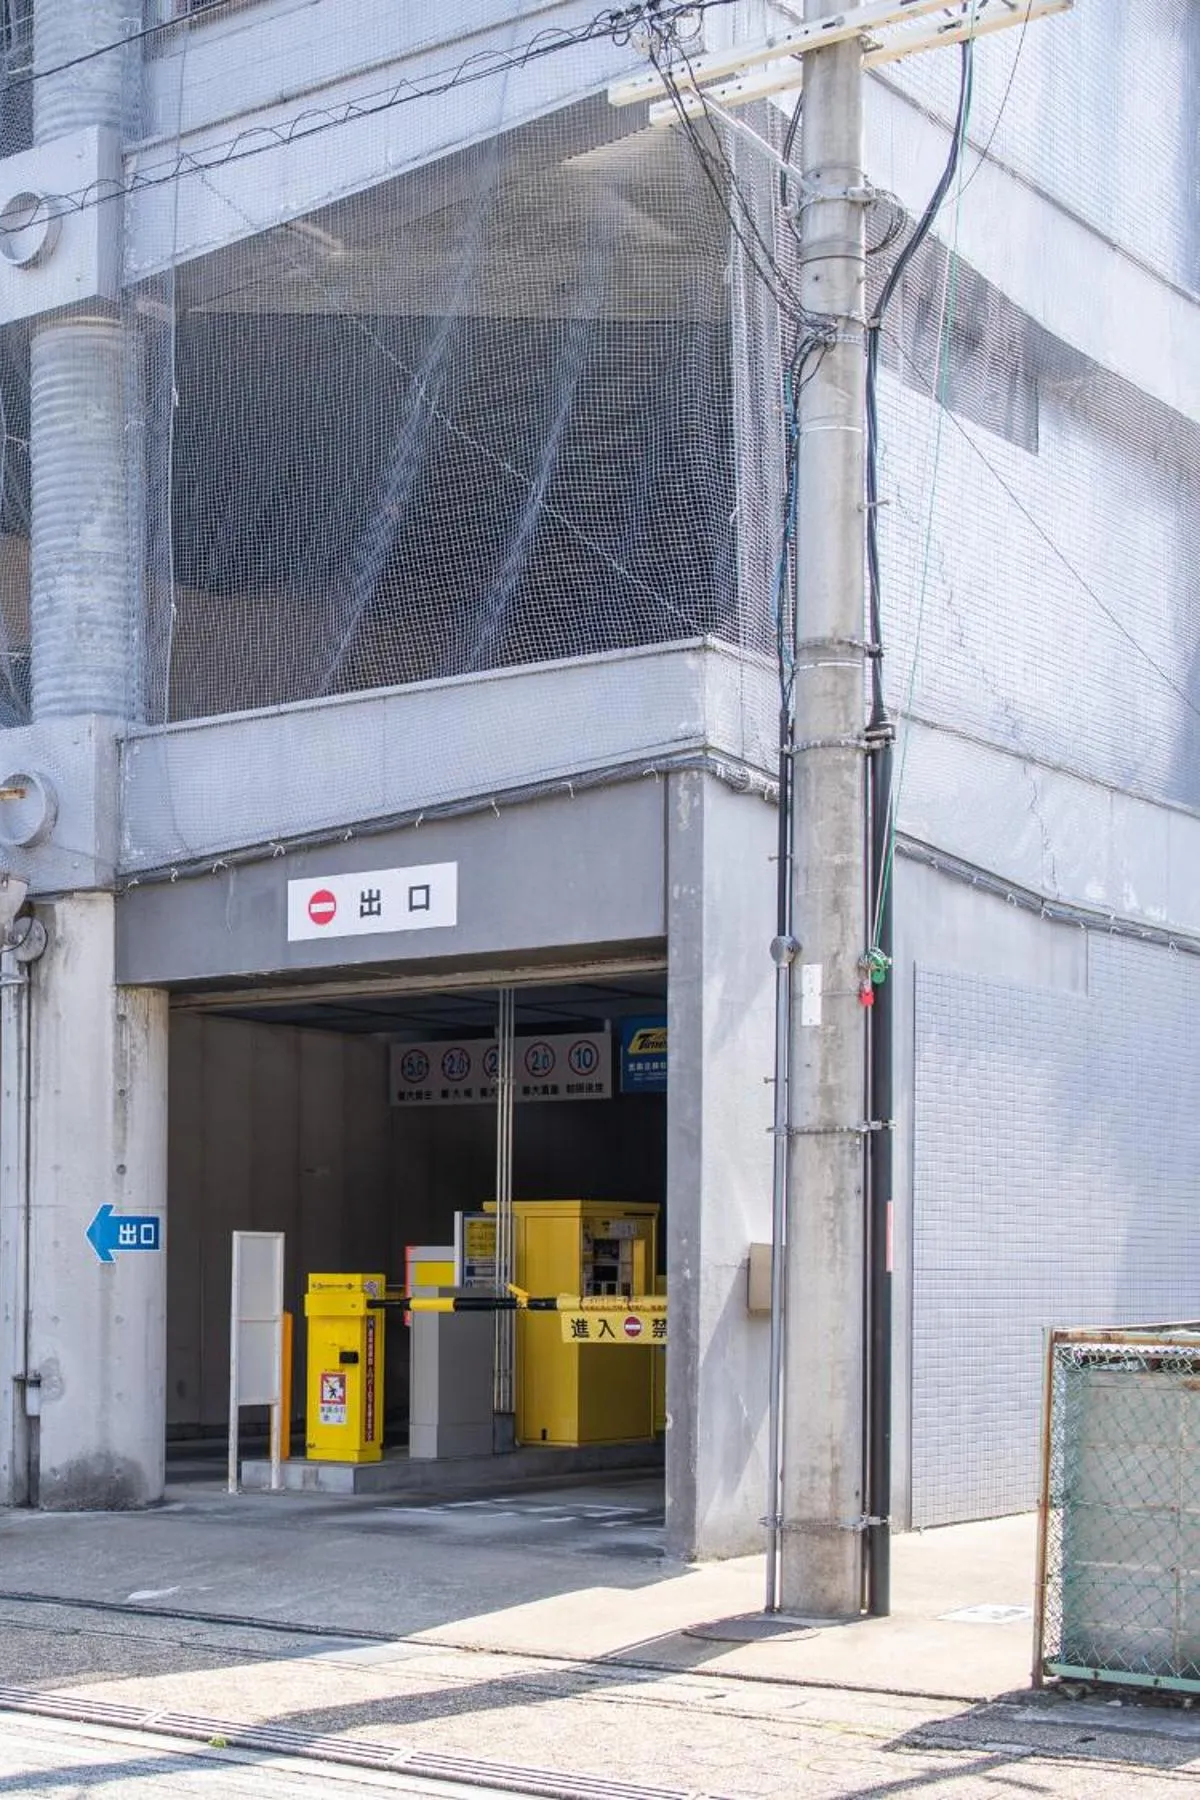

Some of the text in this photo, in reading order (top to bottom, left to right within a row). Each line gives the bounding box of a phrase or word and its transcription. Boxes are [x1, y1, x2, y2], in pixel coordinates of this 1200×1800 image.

[359, 884, 430, 918] 出口
[575, 1047, 593, 1069] 10
[119, 1223, 154, 1245] 出口
